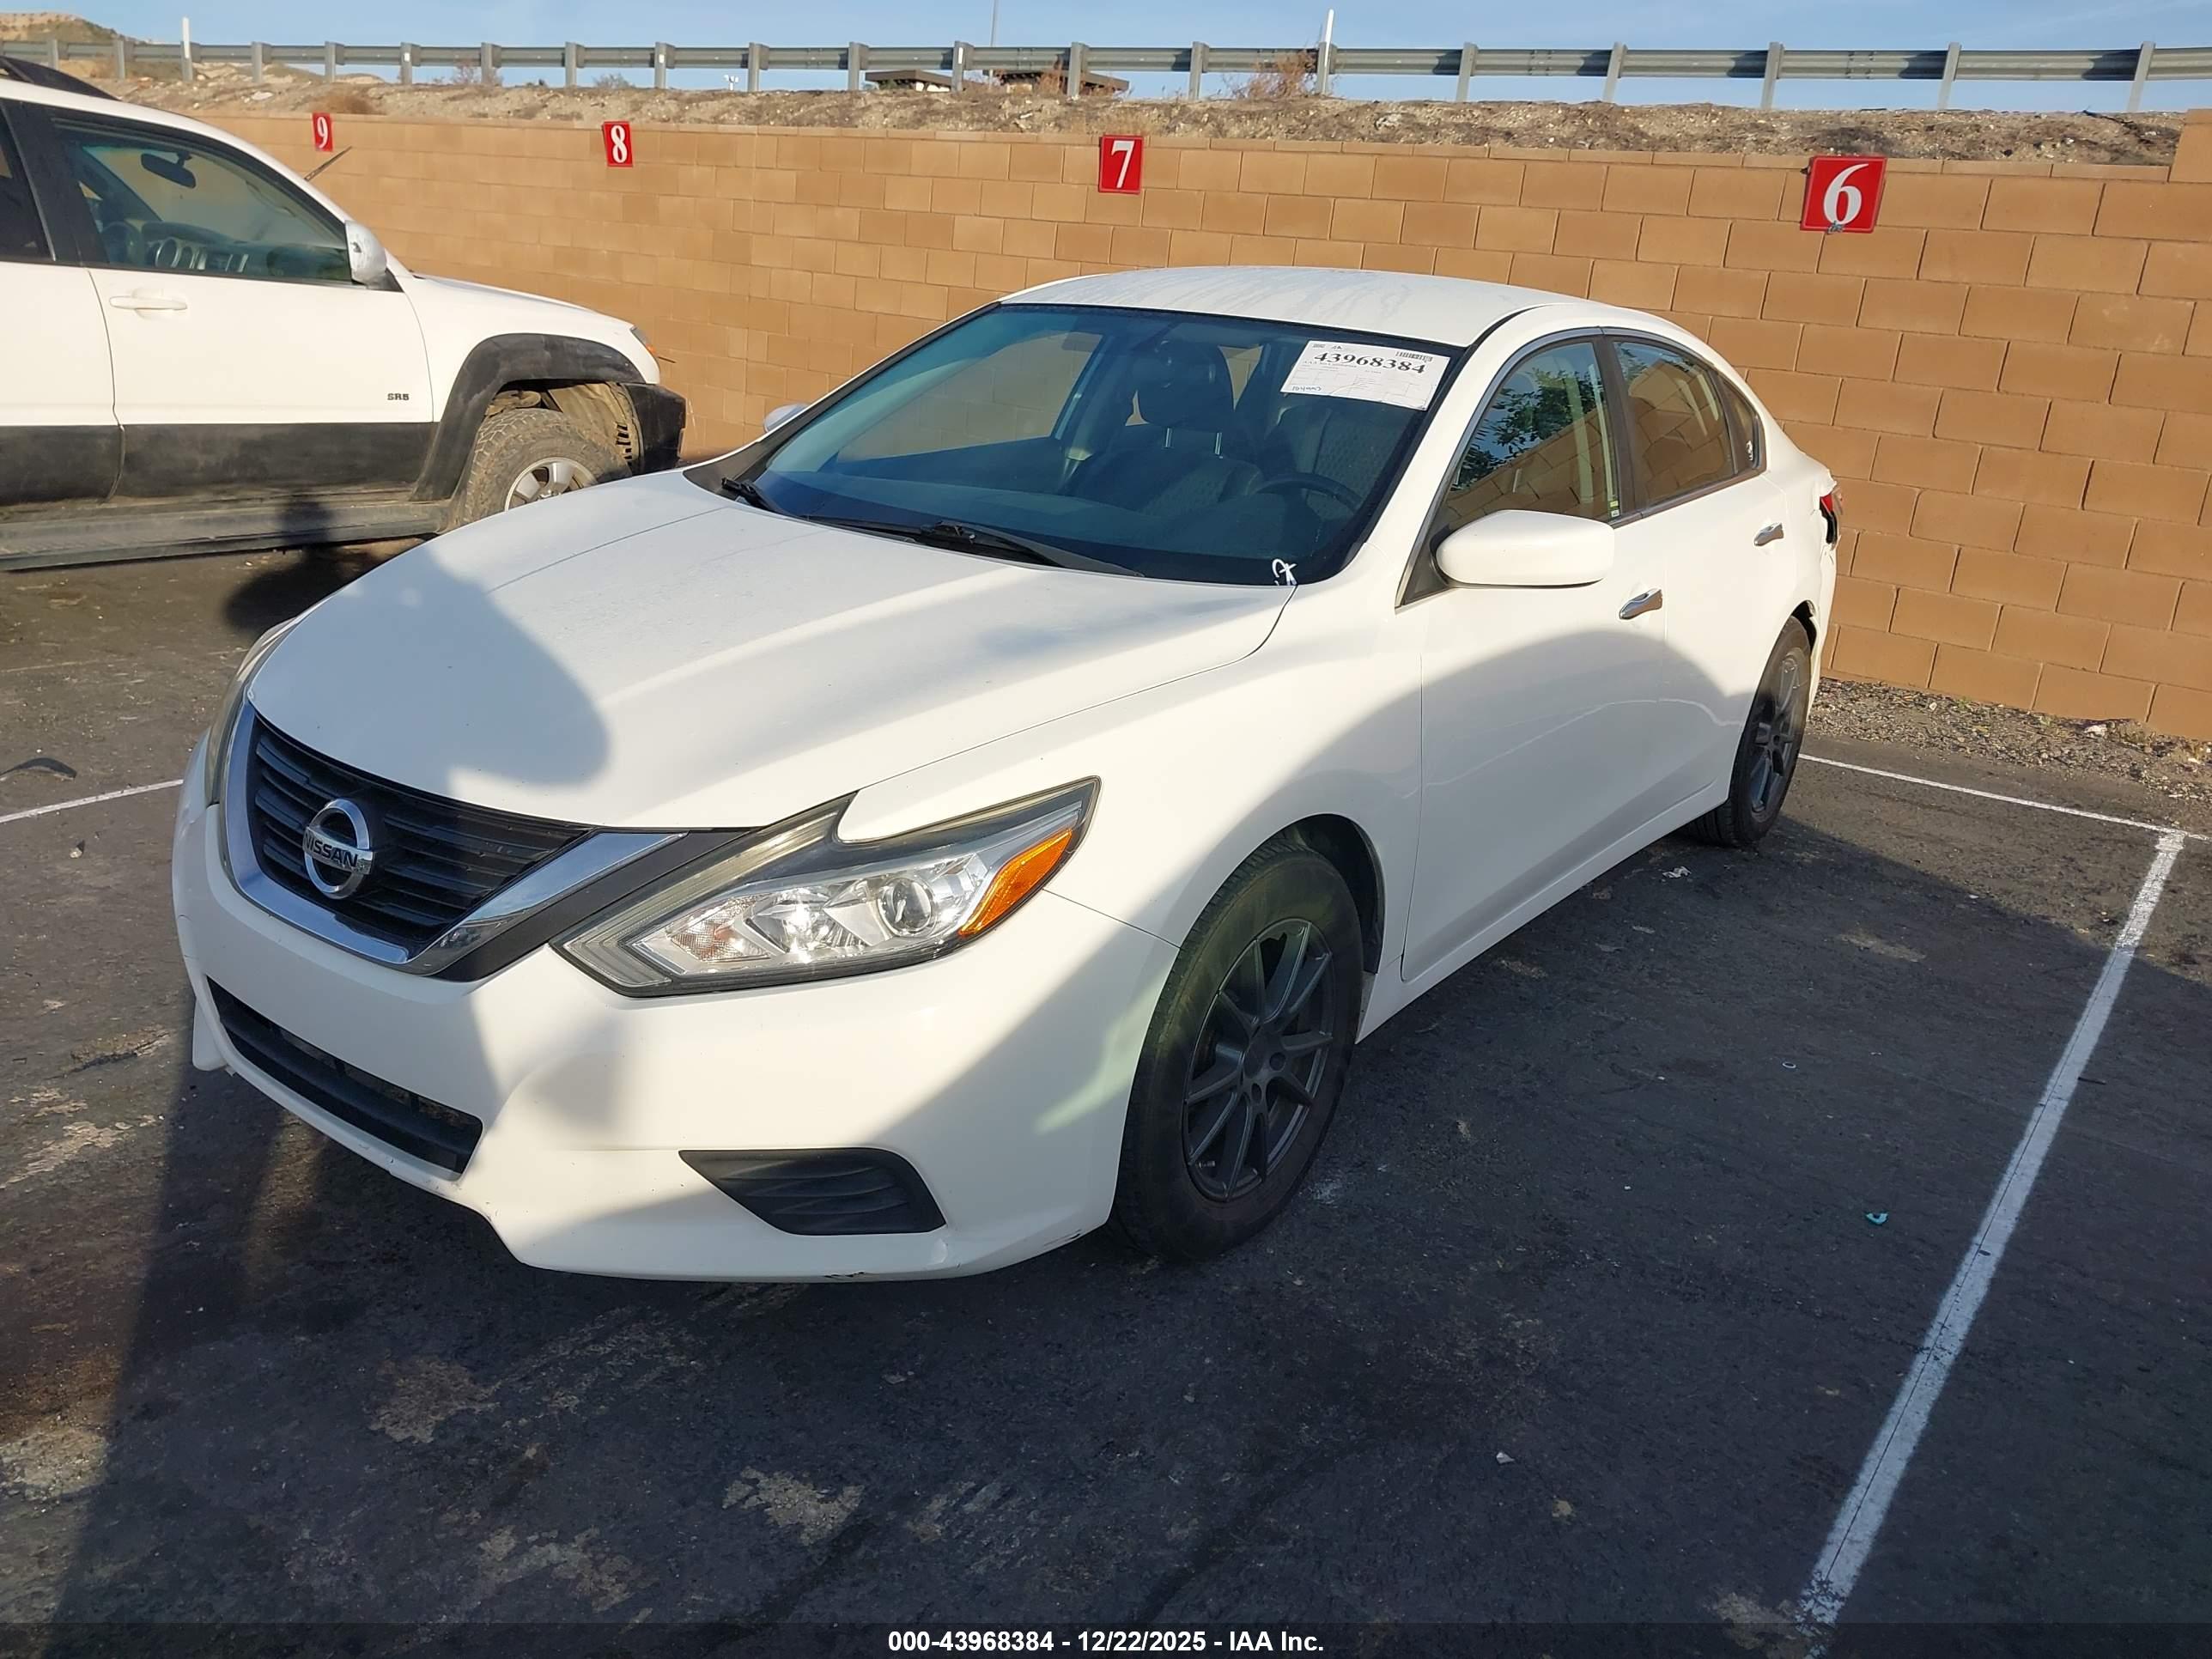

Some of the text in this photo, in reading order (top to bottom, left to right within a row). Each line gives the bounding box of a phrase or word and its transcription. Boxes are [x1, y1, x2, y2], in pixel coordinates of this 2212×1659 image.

[318, 116, 328, 149] 9
[611, 125, 628, 163] 8
[1110, 140, 1135, 188] 7
[1824, 163, 1869, 225] 6
[1314, 352, 1425, 374] 43968384
[303, 830, 358, 867] NISSAN
